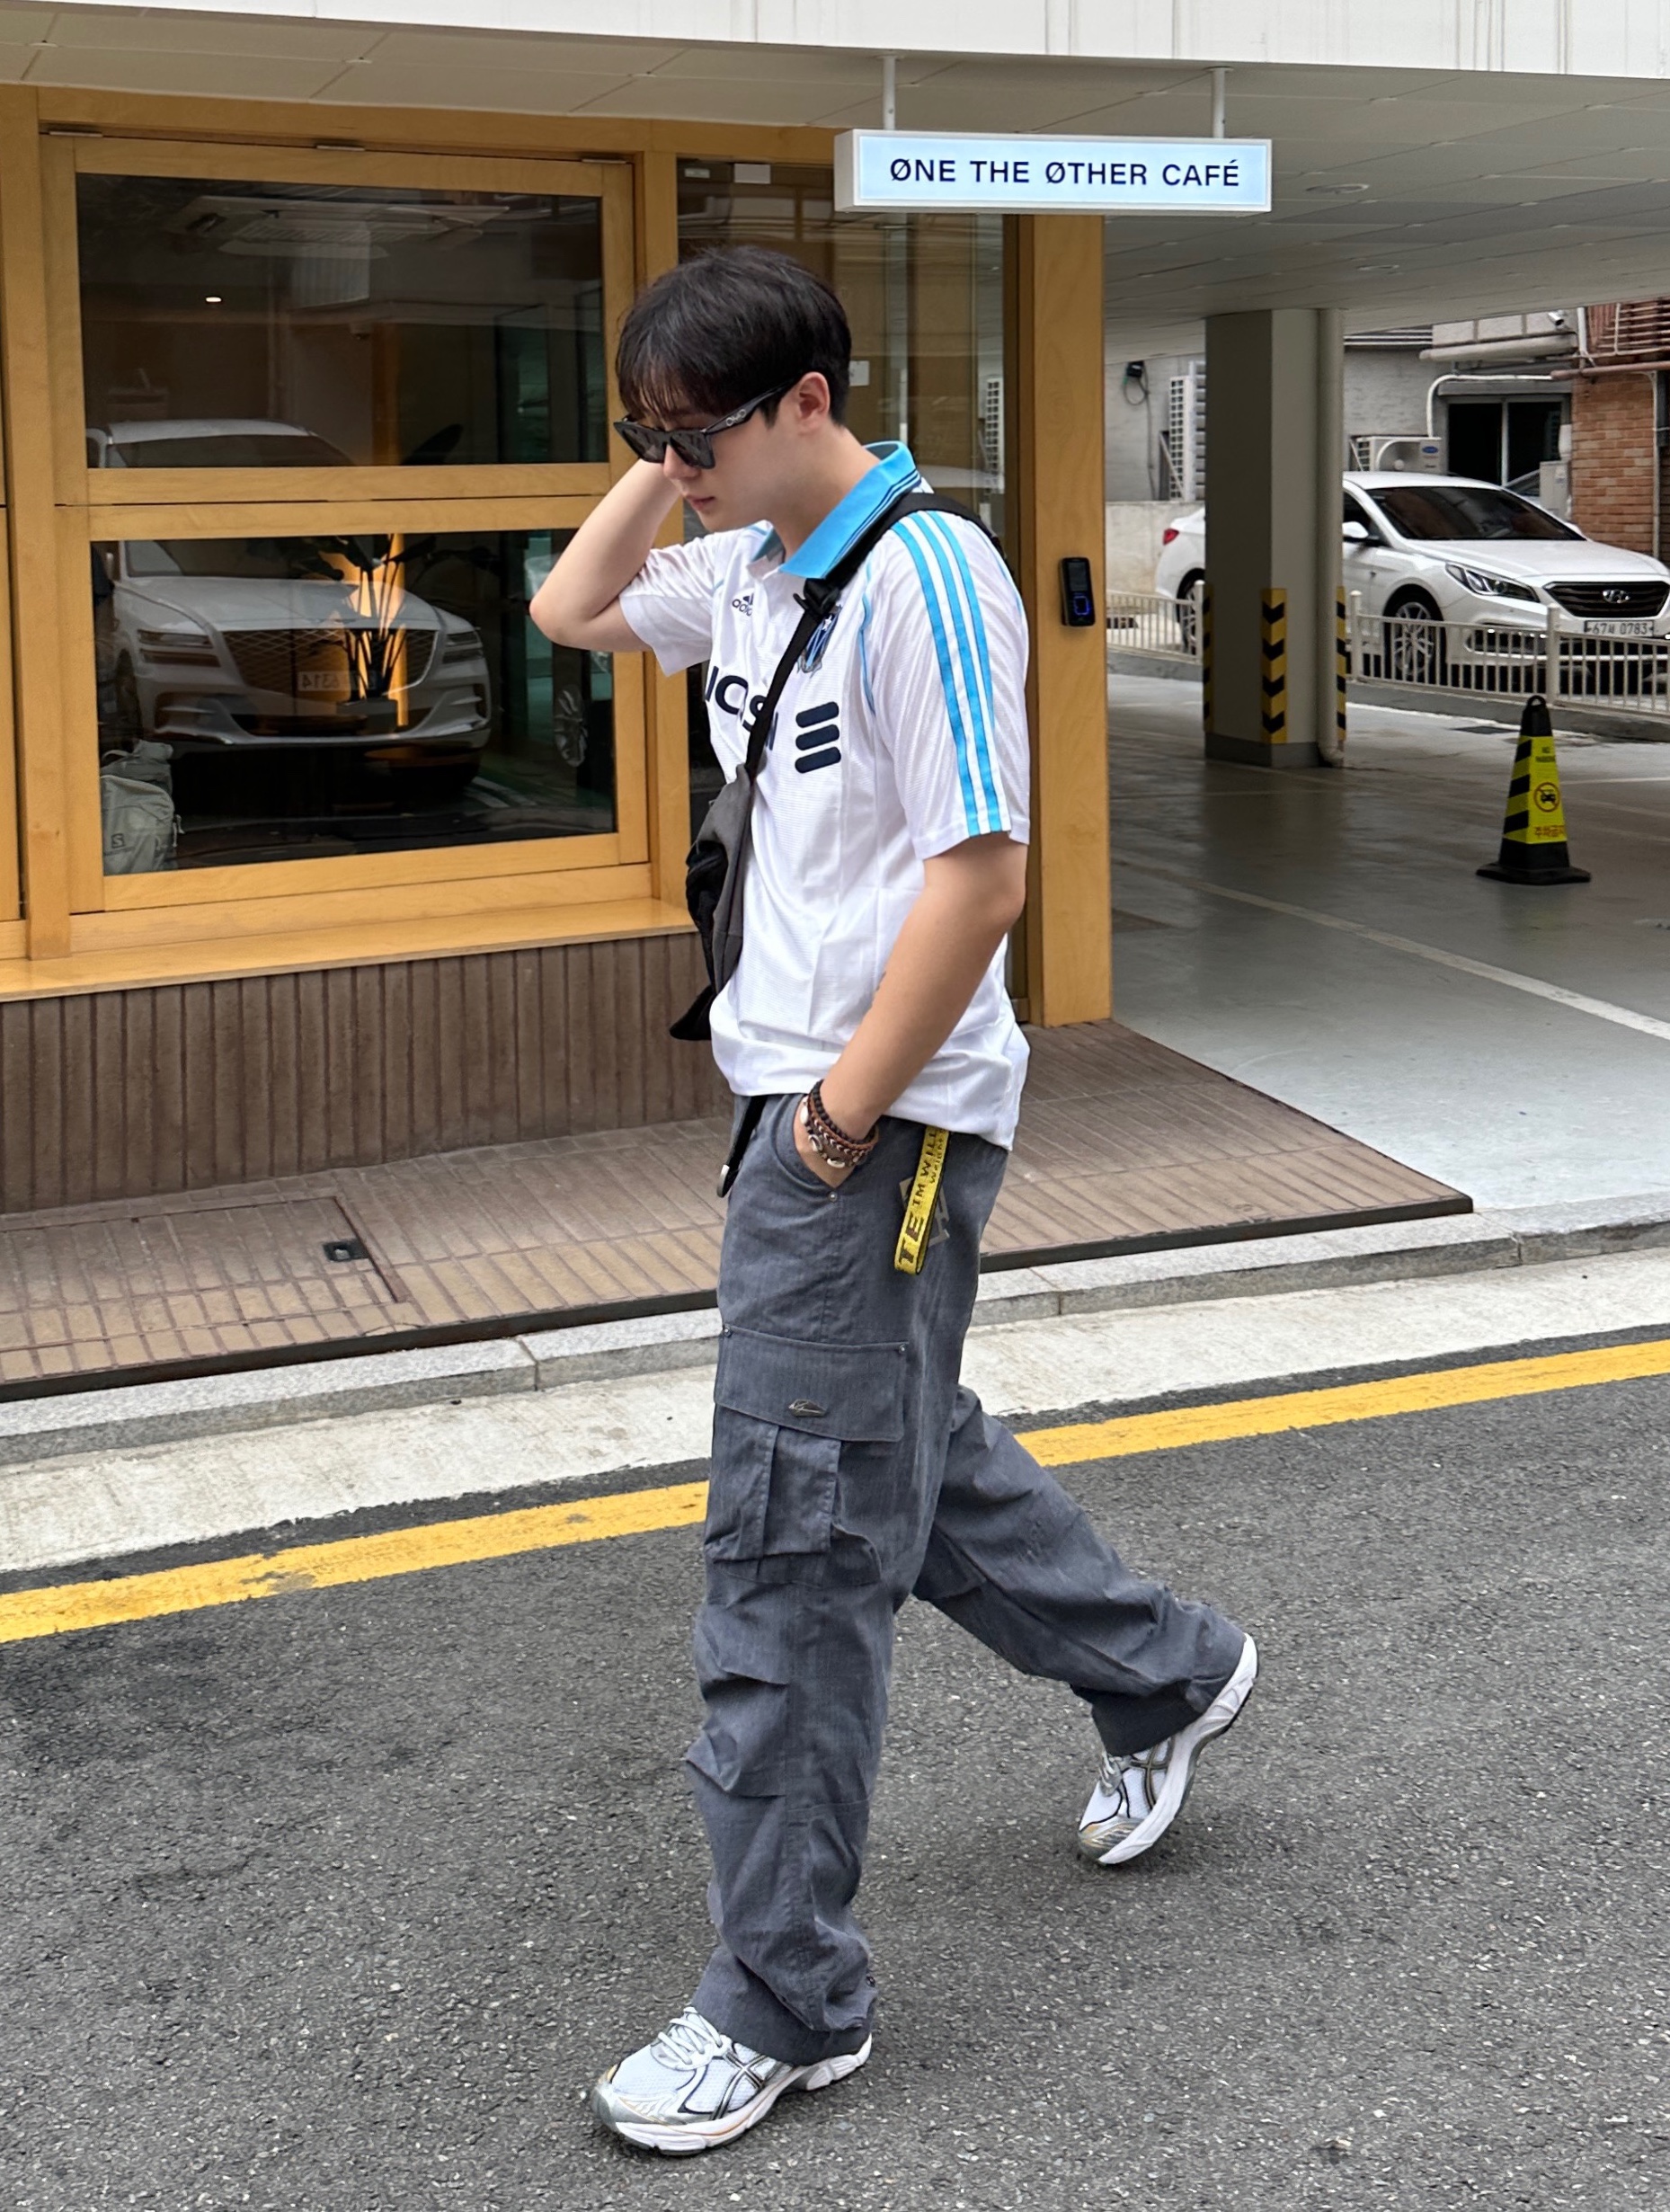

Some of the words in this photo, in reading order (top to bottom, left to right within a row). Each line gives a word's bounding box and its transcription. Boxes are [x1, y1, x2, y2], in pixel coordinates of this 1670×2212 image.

[890, 158, 955, 182] ØNE
[970, 160, 1029, 183] THE
[1045, 162, 1148, 185] ØTHER
[1162, 159, 1239, 186] CAFÉ
[1620, 623, 1648, 635] 0783
